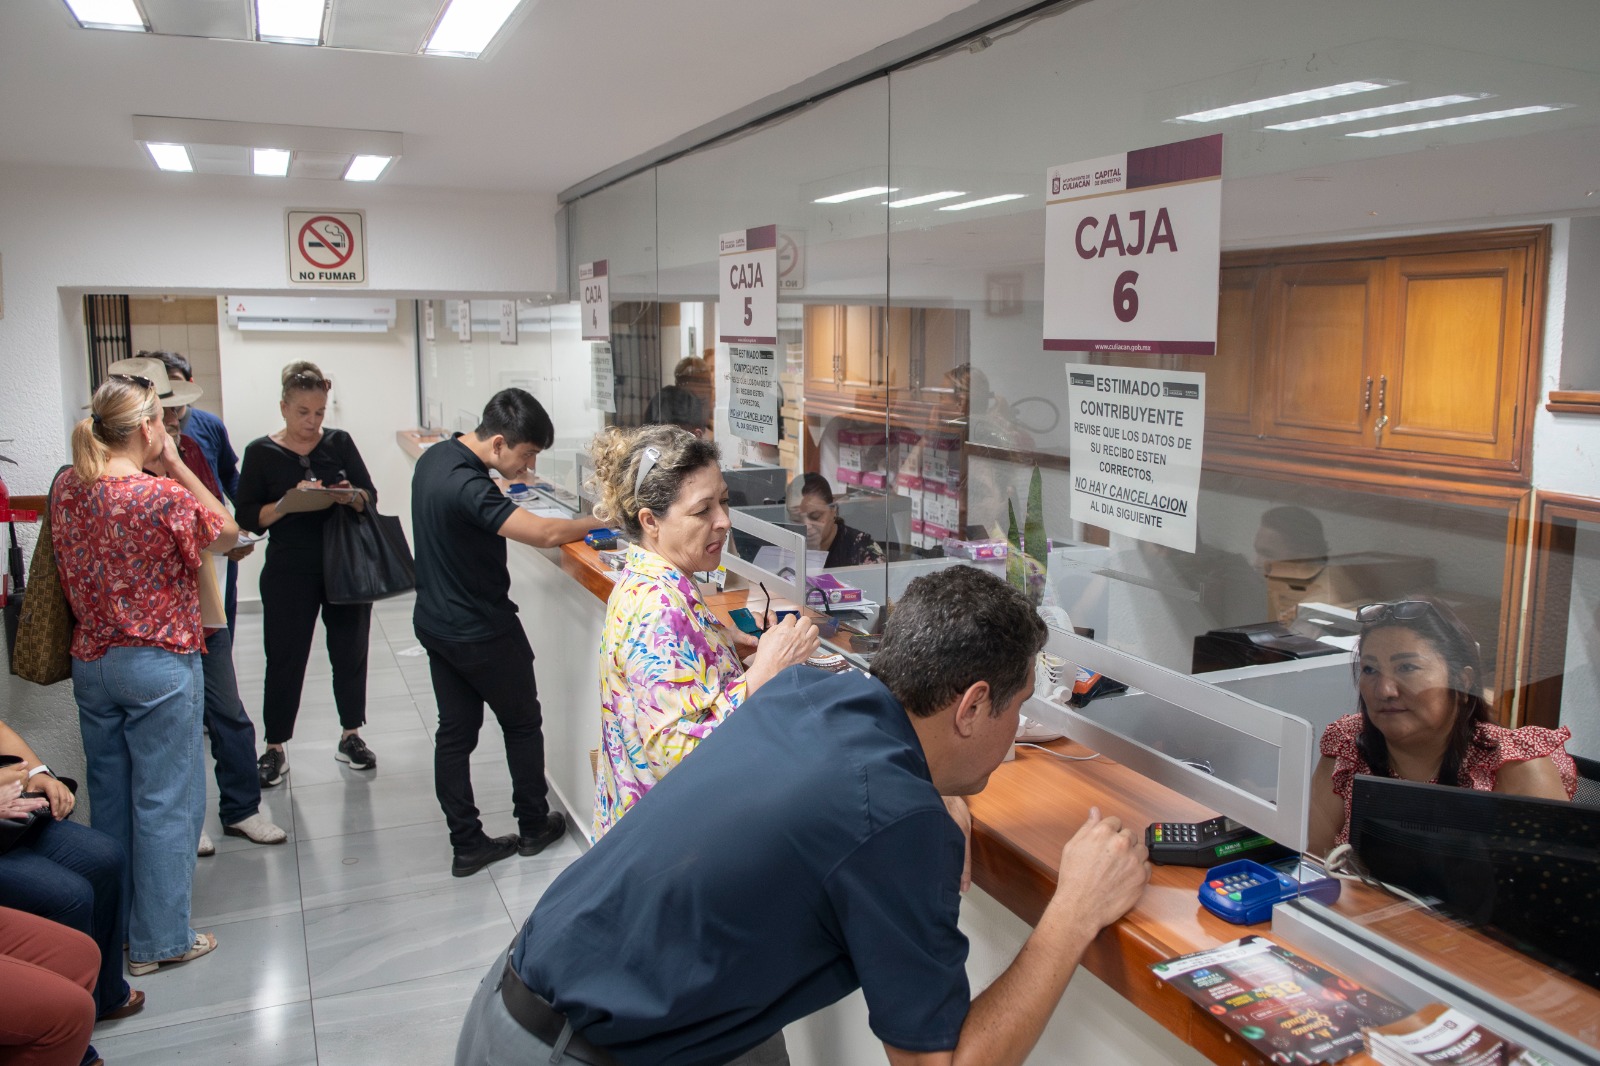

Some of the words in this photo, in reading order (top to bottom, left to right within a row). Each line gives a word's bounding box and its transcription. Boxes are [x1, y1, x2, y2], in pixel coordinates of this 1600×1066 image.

[1095, 168, 1121, 180] CAPITAL
[1075, 207, 1178, 260] CAJA
[299, 271, 315, 280] NO
[318, 271, 356, 280] FUMAR
[730, 262, 764, 290] CAJA
[585, 285, 603, 304] CAJA
[1113, 270, 1139, 323] 6
[592, 308, 597, 330] 4
[744, 296, 753, 327] 5
[739, 349, 760, 360] ESTIMADO
[1094, 343, 1152, 352] www.culiacan.gob.mx
[1096, 377, 1161, 398] ESTIMADO
[744, 411, 774, 424] CANCELACION
[1080, 400, 1184, 427] CONTRIBUYENTE
[1074, 422, 1101, 436] REVISE
[1102, 426, 1120, 440] QUE
[1122, 429, 1139, 442] LOS
[1141, 432, 1175, 448] DATOS
[1177, 437, 1192, 450] DE
[1090, 442, 1101, 454] SU
[1103, 444, 1134, 460] RECIBO
[1136, 450, 1167, 465] ESTEN
[1099, 461, 1154, 483] CORRECTOS,
[1075, 476, 1087, 490] NO
[1088, 479, 1108, 495] HAY
[1109, 484, 1188, 514] CANCELACION
[1090, 500, 1100, 512] AL
[1101, 503, 1114, 516] DIA
[1116, 507, 1163, 528] SIGUIENTE
